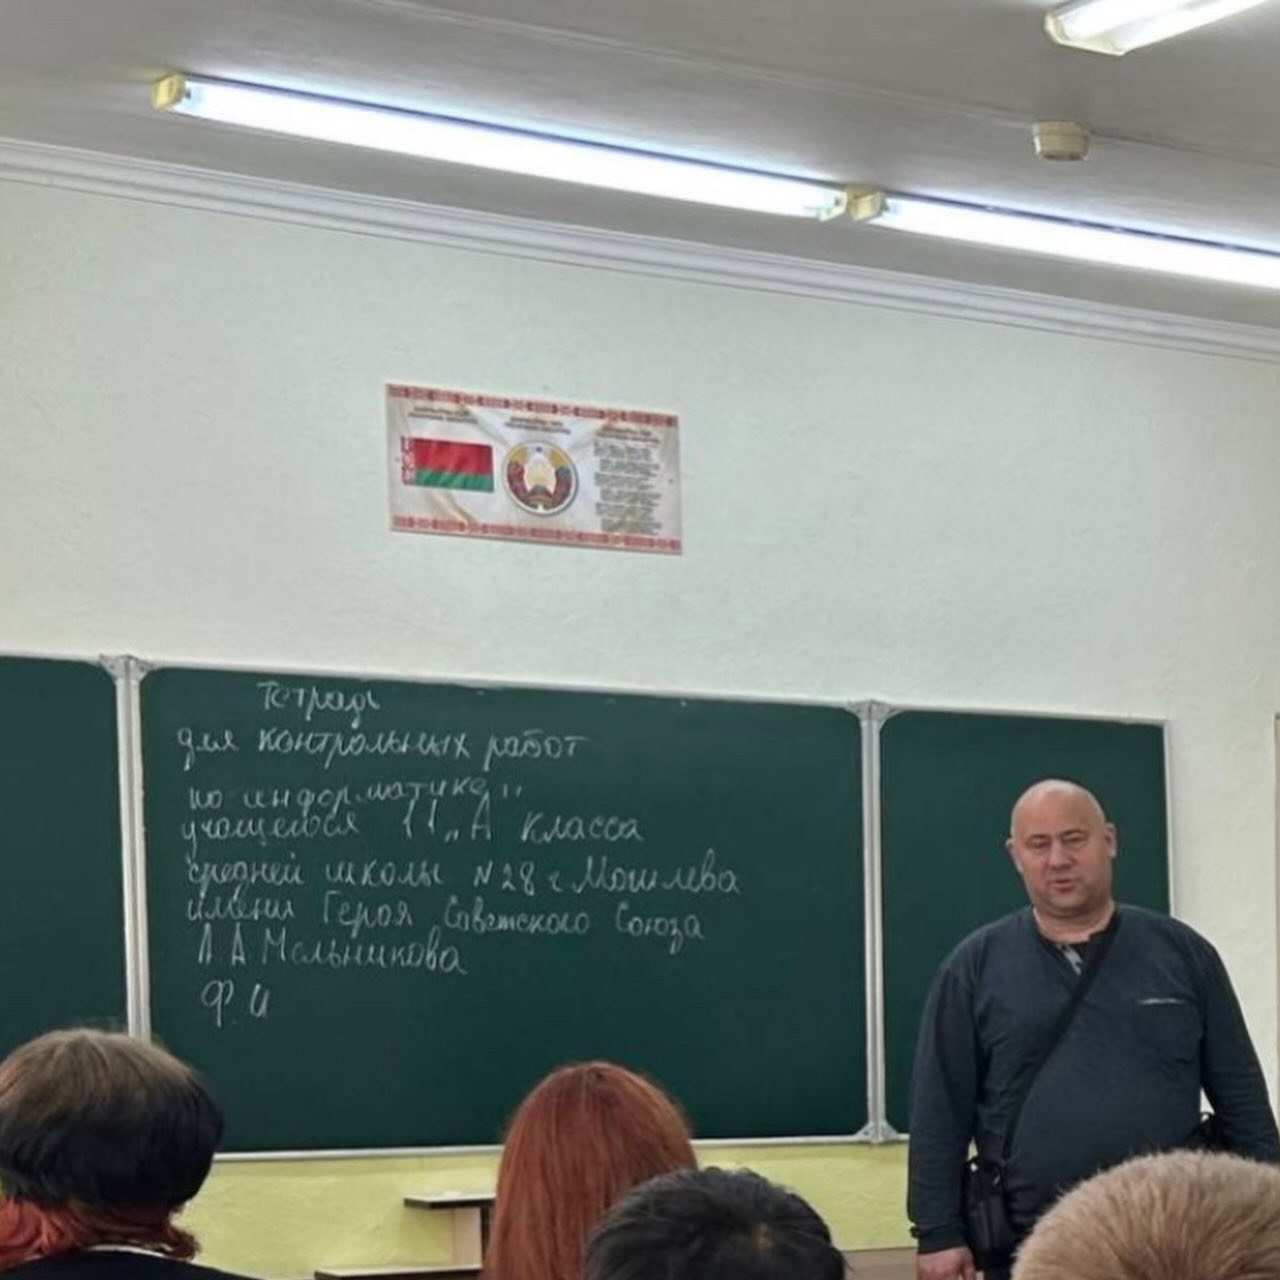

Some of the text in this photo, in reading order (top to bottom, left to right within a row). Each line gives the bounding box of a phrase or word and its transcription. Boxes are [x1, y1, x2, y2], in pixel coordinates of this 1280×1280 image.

[177, 726, 589, 772] для контрольных работ
[190, 776, 487, 818] по информатике
[403, 798, 437, 839] 11
[521, 811, 644, 843] класса
[187, 852, 304, 899] средней
[325, 859, 443, 888] школы
[187, 889, 704, 955] имени Героя Советского Союза
[262, 925, 468, 975] Мельникова
